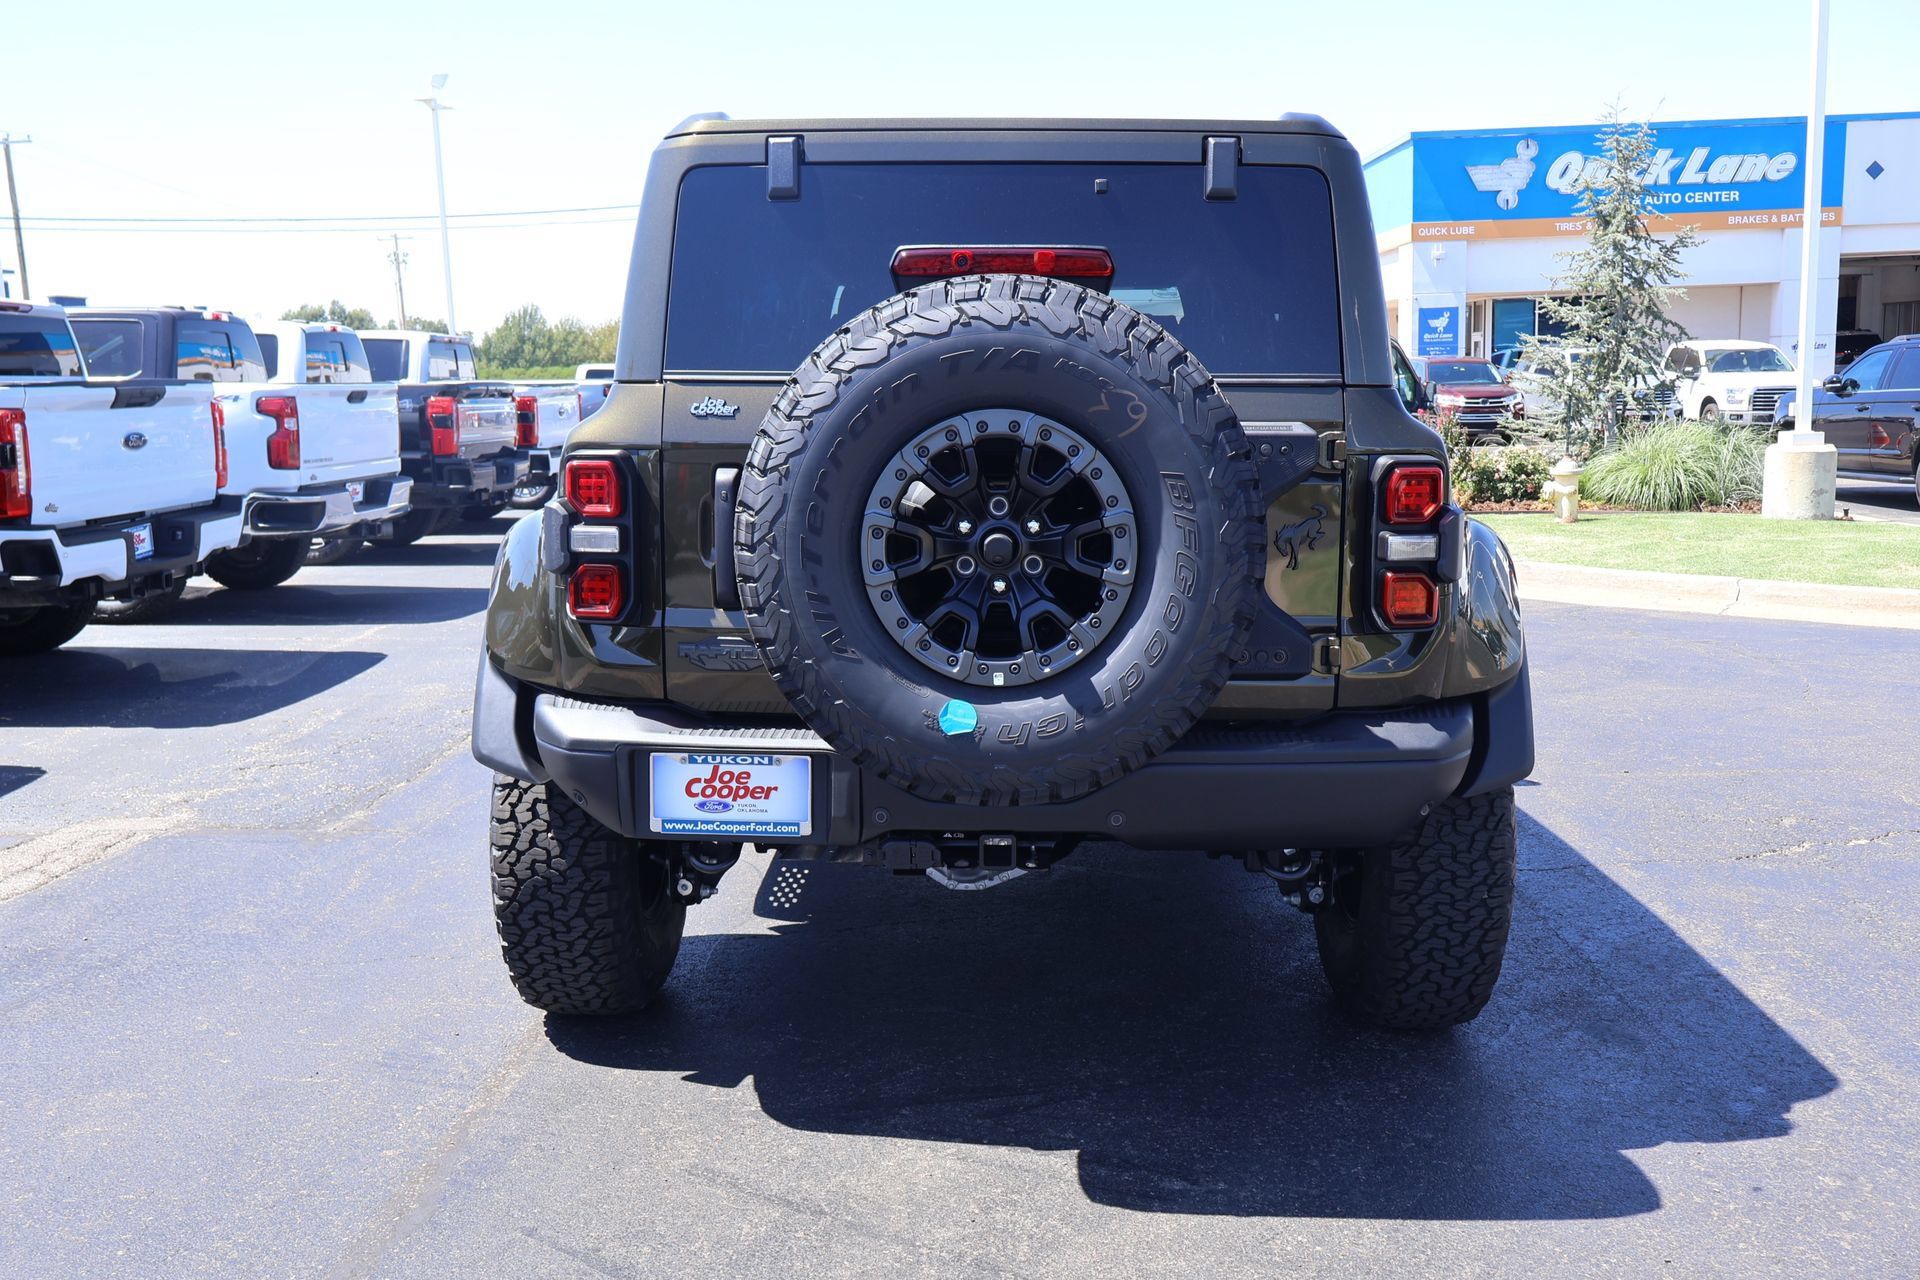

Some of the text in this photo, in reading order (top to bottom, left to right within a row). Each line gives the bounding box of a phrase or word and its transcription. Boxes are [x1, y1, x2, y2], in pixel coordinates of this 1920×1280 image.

[1676, 146, 1798, 185] Lane
[1644, 192, 1682, 205] AUTO
[1684, 191, 1740, 203] CENTER
[1728, 212, 1836, 225] BRAKES & BATTIES
[1418, 225, 1476, 237] QUICK LUBE
[1555, 221, 1582, 232] TIRES
[1586, 221, 1592, 230] &
[702, 396, 726, 407] Joe
[690, 402, 739, 416] Cooper
[995, 471, 1199, 746] BFGoodrich
[692, 755, 770, 765] YUKON
[703, 764, 752, 785] Joe
[684, 777, 779, 801] Cooper
[663, 822, 799, 833] www.JoeCooperFord.com
